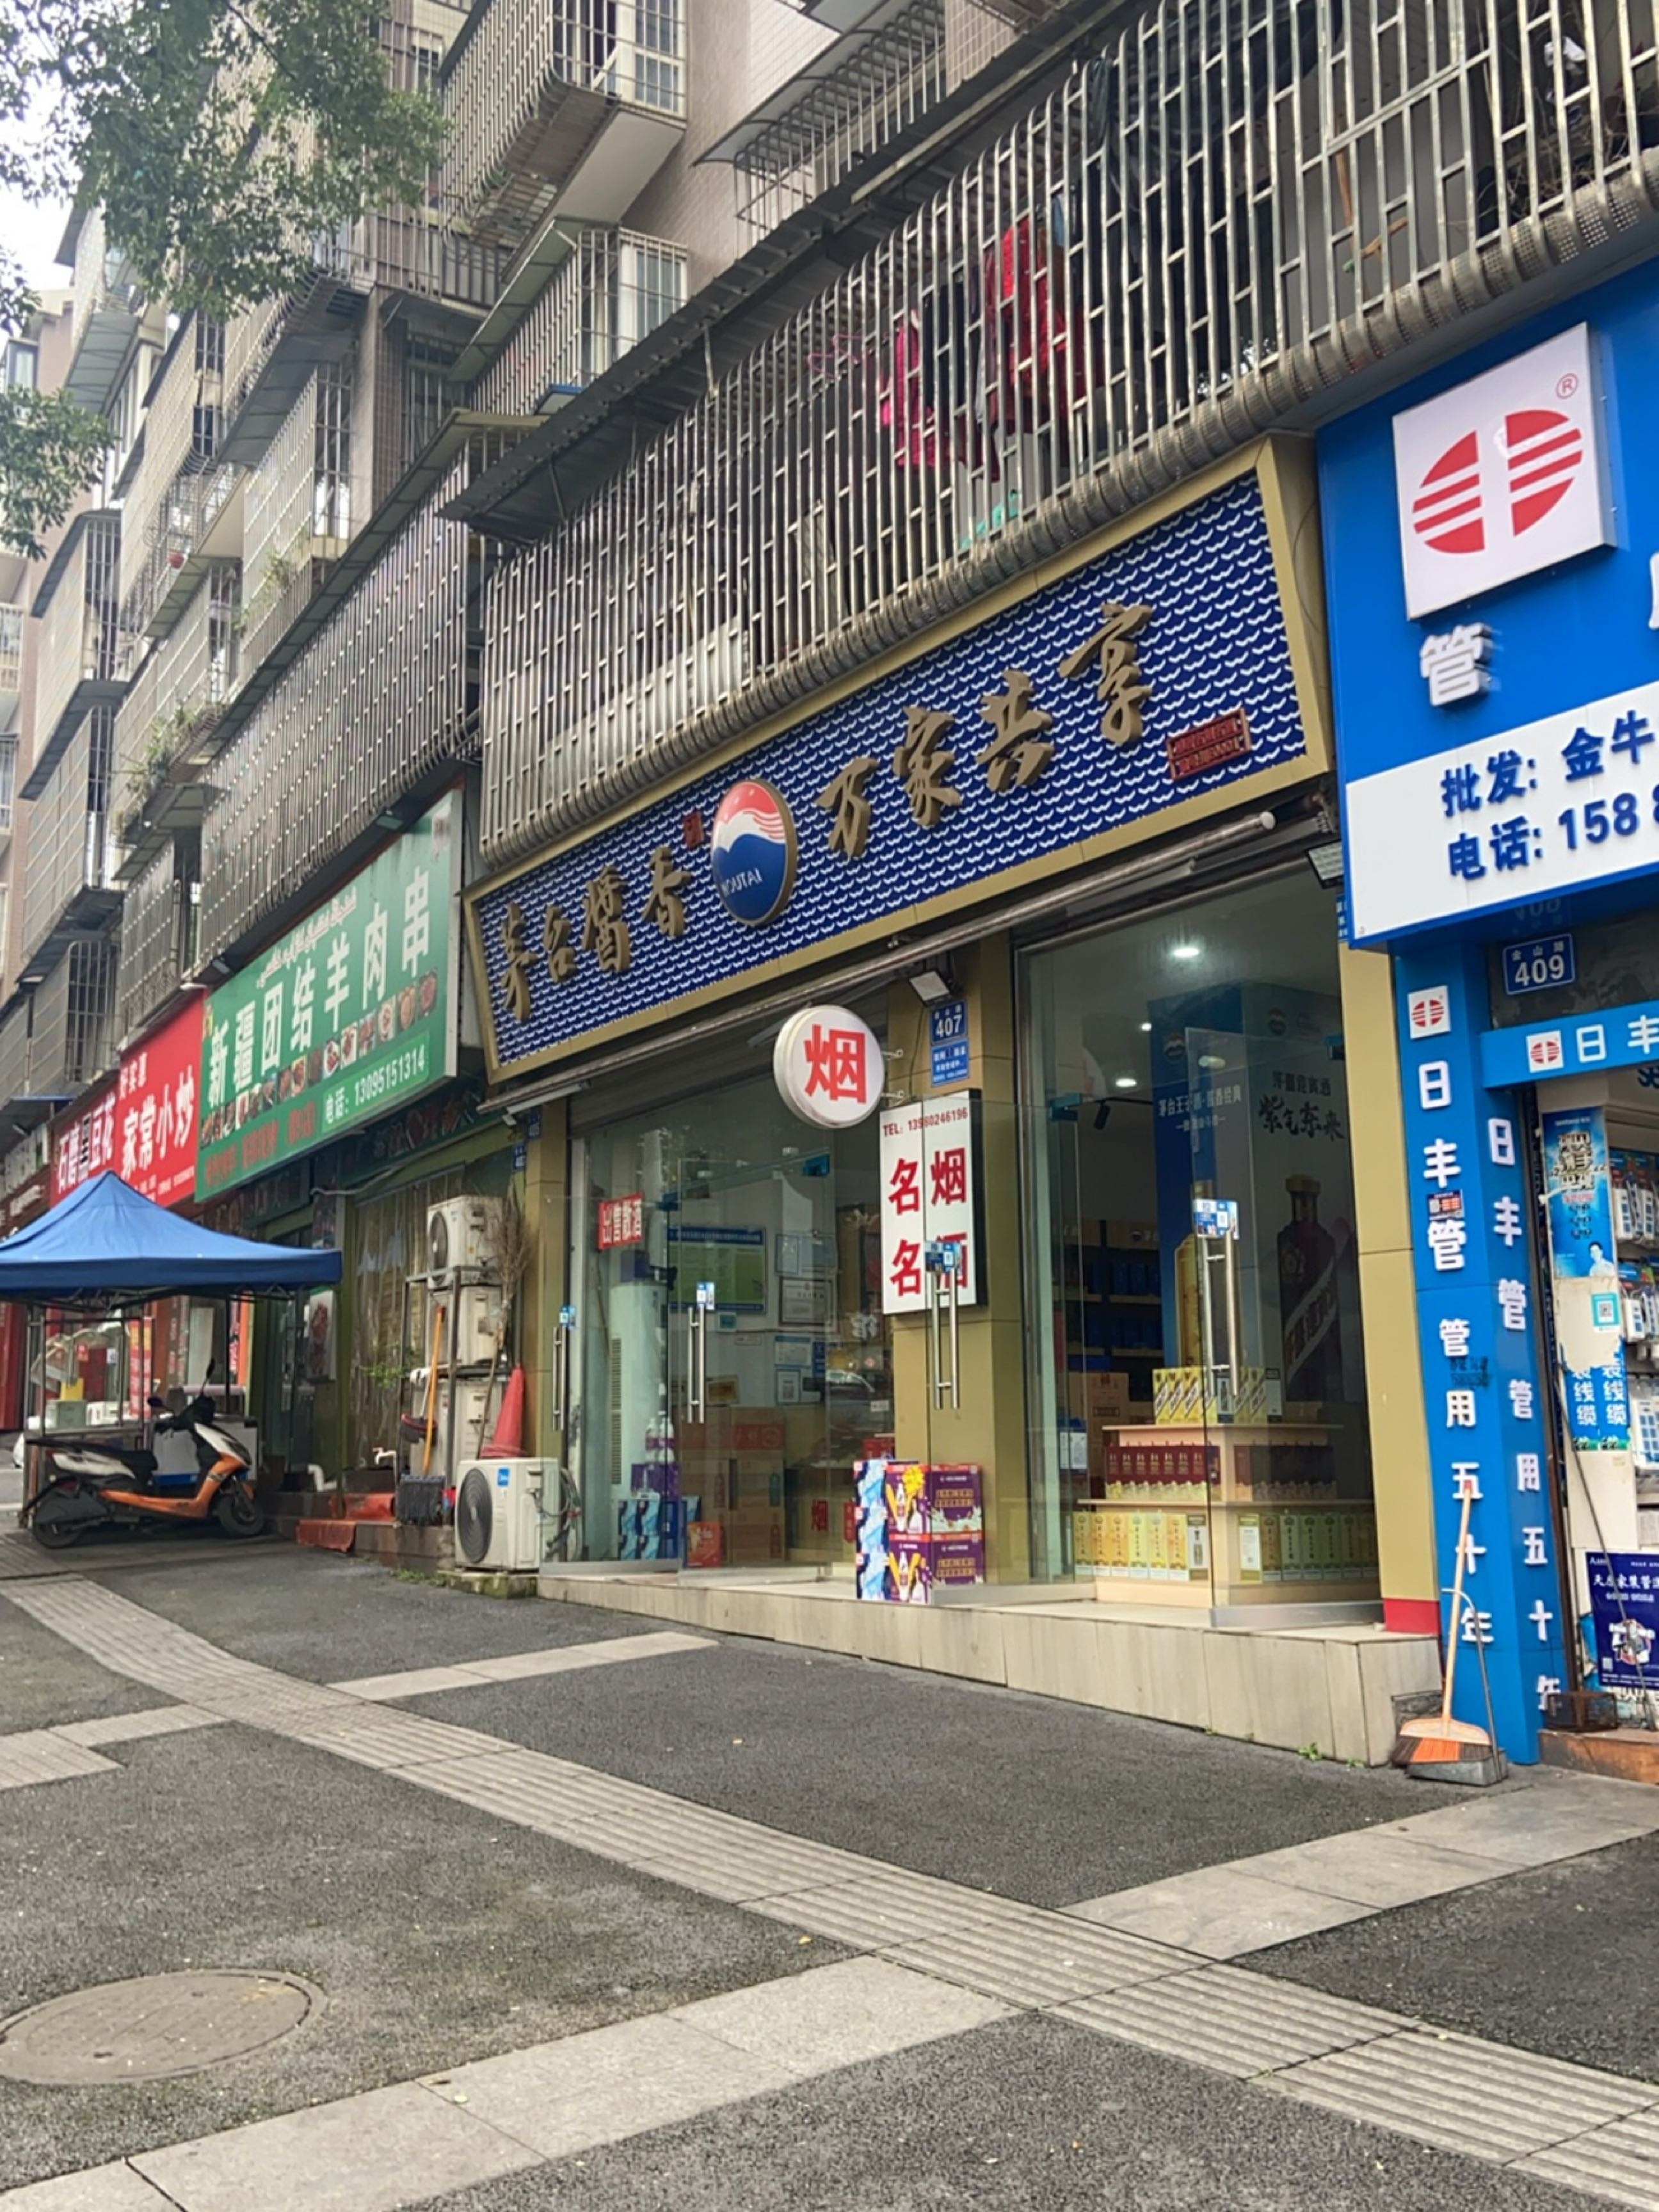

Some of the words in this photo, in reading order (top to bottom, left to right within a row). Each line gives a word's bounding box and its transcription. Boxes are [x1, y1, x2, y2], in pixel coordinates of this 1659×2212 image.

[1420, 622, 1489, 708] 管
[1561, 709, 1656, 783] 金牛
[206, 865, 430, 1109] 新疆团结羊肉串
[1514, 954, 1565, 986] 409
[803, 1023, 867, 1104] 烟
[936, 1014, 963, 1038] 407
[1576, 1014, 1659, 1063] 日丰
[121, 1064, 195, 1180] 家常小炒
